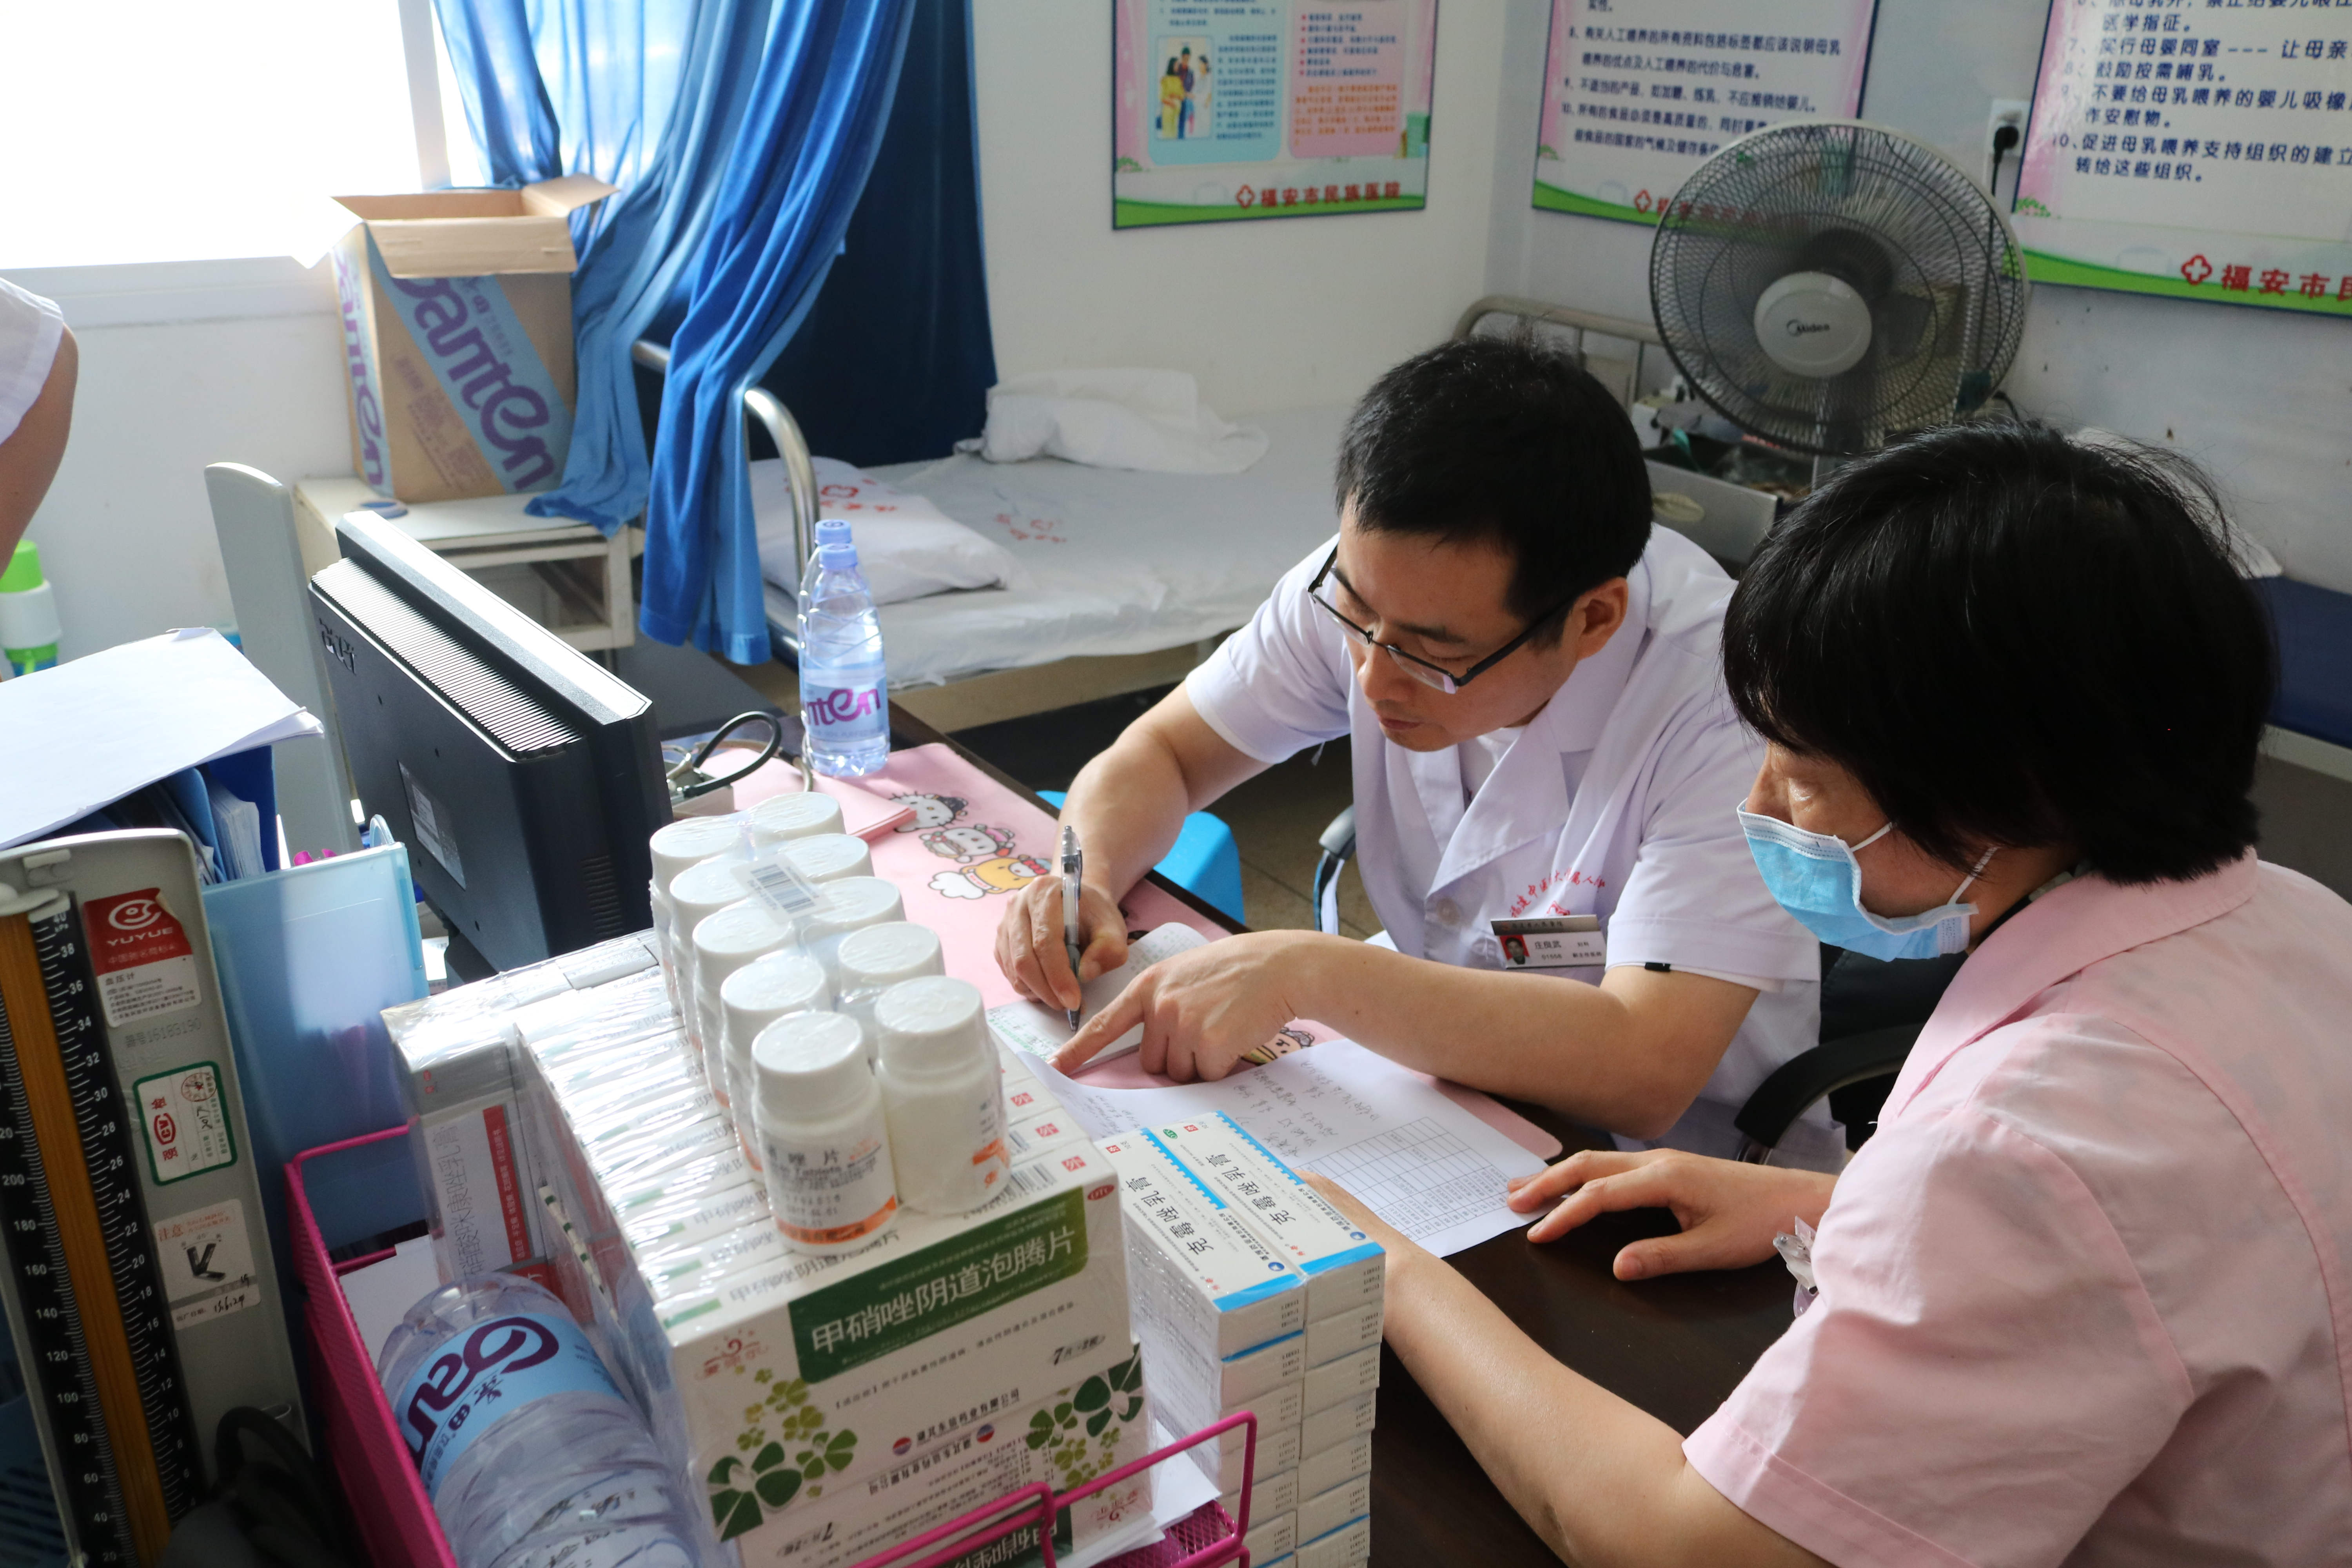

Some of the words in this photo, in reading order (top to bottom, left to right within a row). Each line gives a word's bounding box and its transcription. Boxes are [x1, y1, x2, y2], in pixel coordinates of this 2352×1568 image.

[2062, 84, 2352, 111] 9、不要给母乳喂养的婴儿吸橡
[2086, 107, 2171, 128] 作安慰物。
[2076, 156, 2202, 183] 转给这些组织。
[1261, 181, 1401, 208] 福安市民族医院
[1796, 323, 1830, 334] Midea
[107, 927, 173, 946] YUYUE
[60, 943, 75, 958] 38
[69, 980, 83, 995] 36
[78, 1016, 92, 1031] 34
[86, 1052, 100, 1067] 32
[94, 1087, 108, 1102] 30
[1011, 1092, 1033, 1107] 外
[151, 1096, 168, 1109] 检
[102, 1122, 116, 1136] 28
[1036, 1123, 1059, 1138] 外
[1164, 1129, 1177, 1139] OTC
[162, 1146, 178, 1161] 强
[110, 1156, 123, 1170] 26
[1062, 1156, 1086, 1173] 外
[2, 1174, 25, 1186] 200
[118, 1189, 131, 1203] 24
[1089, 1187, 1113, 1200] OTC
[1205, 1153, 1296, 1225] 克霉唑乳膏
[432, 1125, 485, 1276] 硝酸咪康唑乳膏
[1125, 1176, 1214, 1256] 克霉唑乳膏
[14, 1219, 36, 1231] 180
[125, 1222, 138, 1236] 22
[158, 1225, 183, 1242] 注意
[132, 1255, 145, 1269] 20
[730, 1229, 900, 1303] 甲硝唑阴道片
[25, 1263, 47, 1276] 160
[140, 1286, 152, 1300] 18
[811, 1226, 1076, 1355] 甲硝唑阴道泡腾片
[36, 1307, 58, 1319] 140
[147, 1318, 159, 1331] 16
[46, 1350, 69, 1362] 120
[154, 1348, 166, 1361] 14
[161, 1378, 172, 1391] 12
[57, 1392, 79, 1403] 100
[168, 1408, 179, 1421] 10
[74, 1433, 89, 1444] 80
[83, 1472, 98, 1484] 60
[94, 1511, 108, 1522] 40
[102, 1551, 116, 1562] 20
